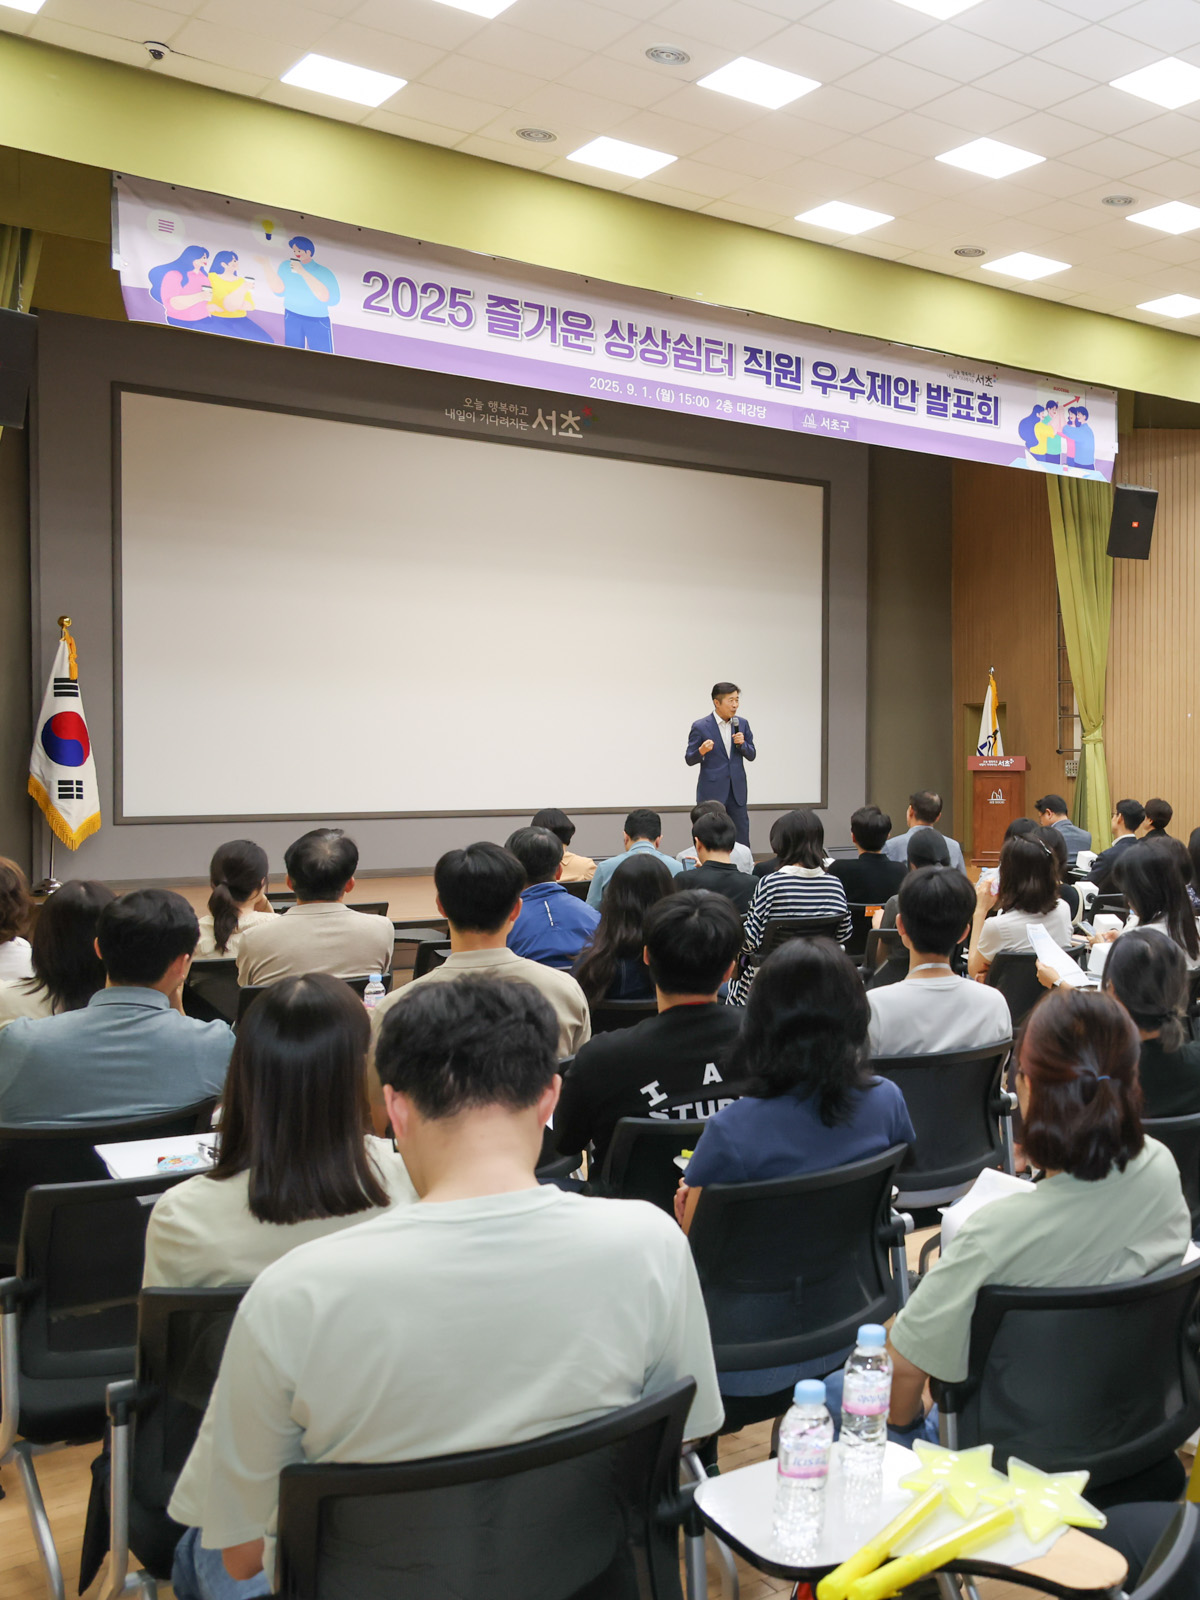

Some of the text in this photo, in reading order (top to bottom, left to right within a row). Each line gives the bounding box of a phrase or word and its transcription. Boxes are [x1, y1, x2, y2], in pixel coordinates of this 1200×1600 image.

[361, 270, 999, 427] 2025 즐거운 상상쉼터 직원 우수제안 발표회
[975, 374, 994, 388] 서초
[463, 397, 529, 416] 오늘 행복하고
[590, 376, 767, 419] 2025. 9. 1. (월) 15:00 2층 대강당
[444, 408, 530, 431] 내일이 기다려지는
[531, 408, 584, 439] 서초
[820, 416, 850, 433] 서초구
[702, 1062, 724, 1086] A
